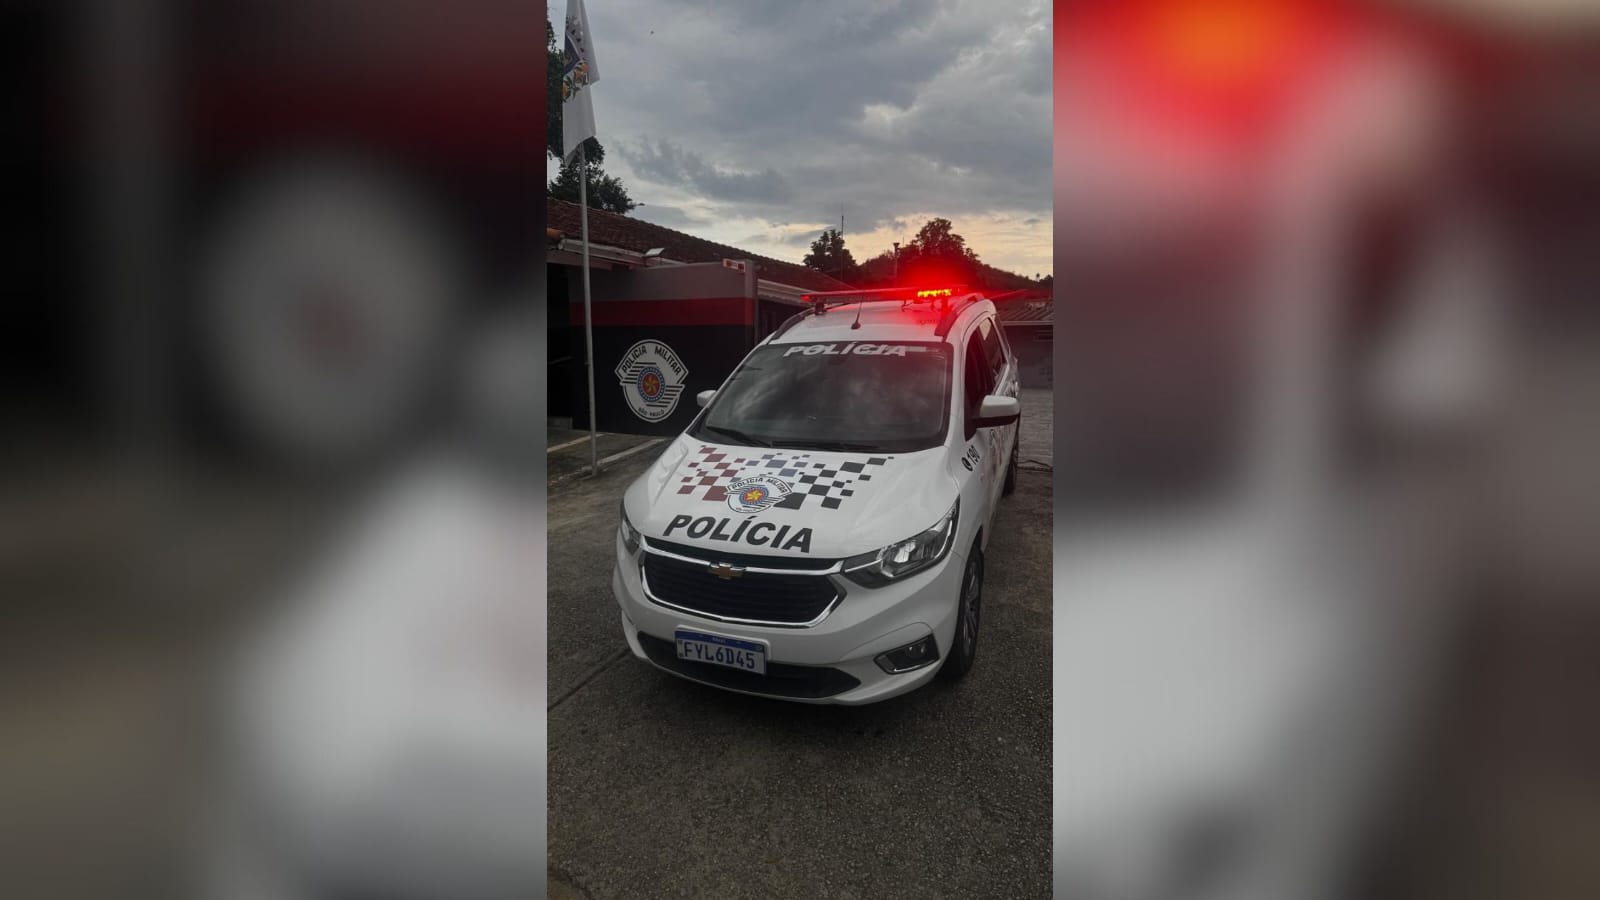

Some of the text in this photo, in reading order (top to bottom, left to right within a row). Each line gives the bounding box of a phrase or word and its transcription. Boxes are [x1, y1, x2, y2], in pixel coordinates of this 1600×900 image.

[654, 346, 682, 376] MILITAR
[782, 341, 906, 357] POLÍCIA
[662, 515, 814, 554] POLÍCIA
[684, 641, 755, 669] FYL6D45
